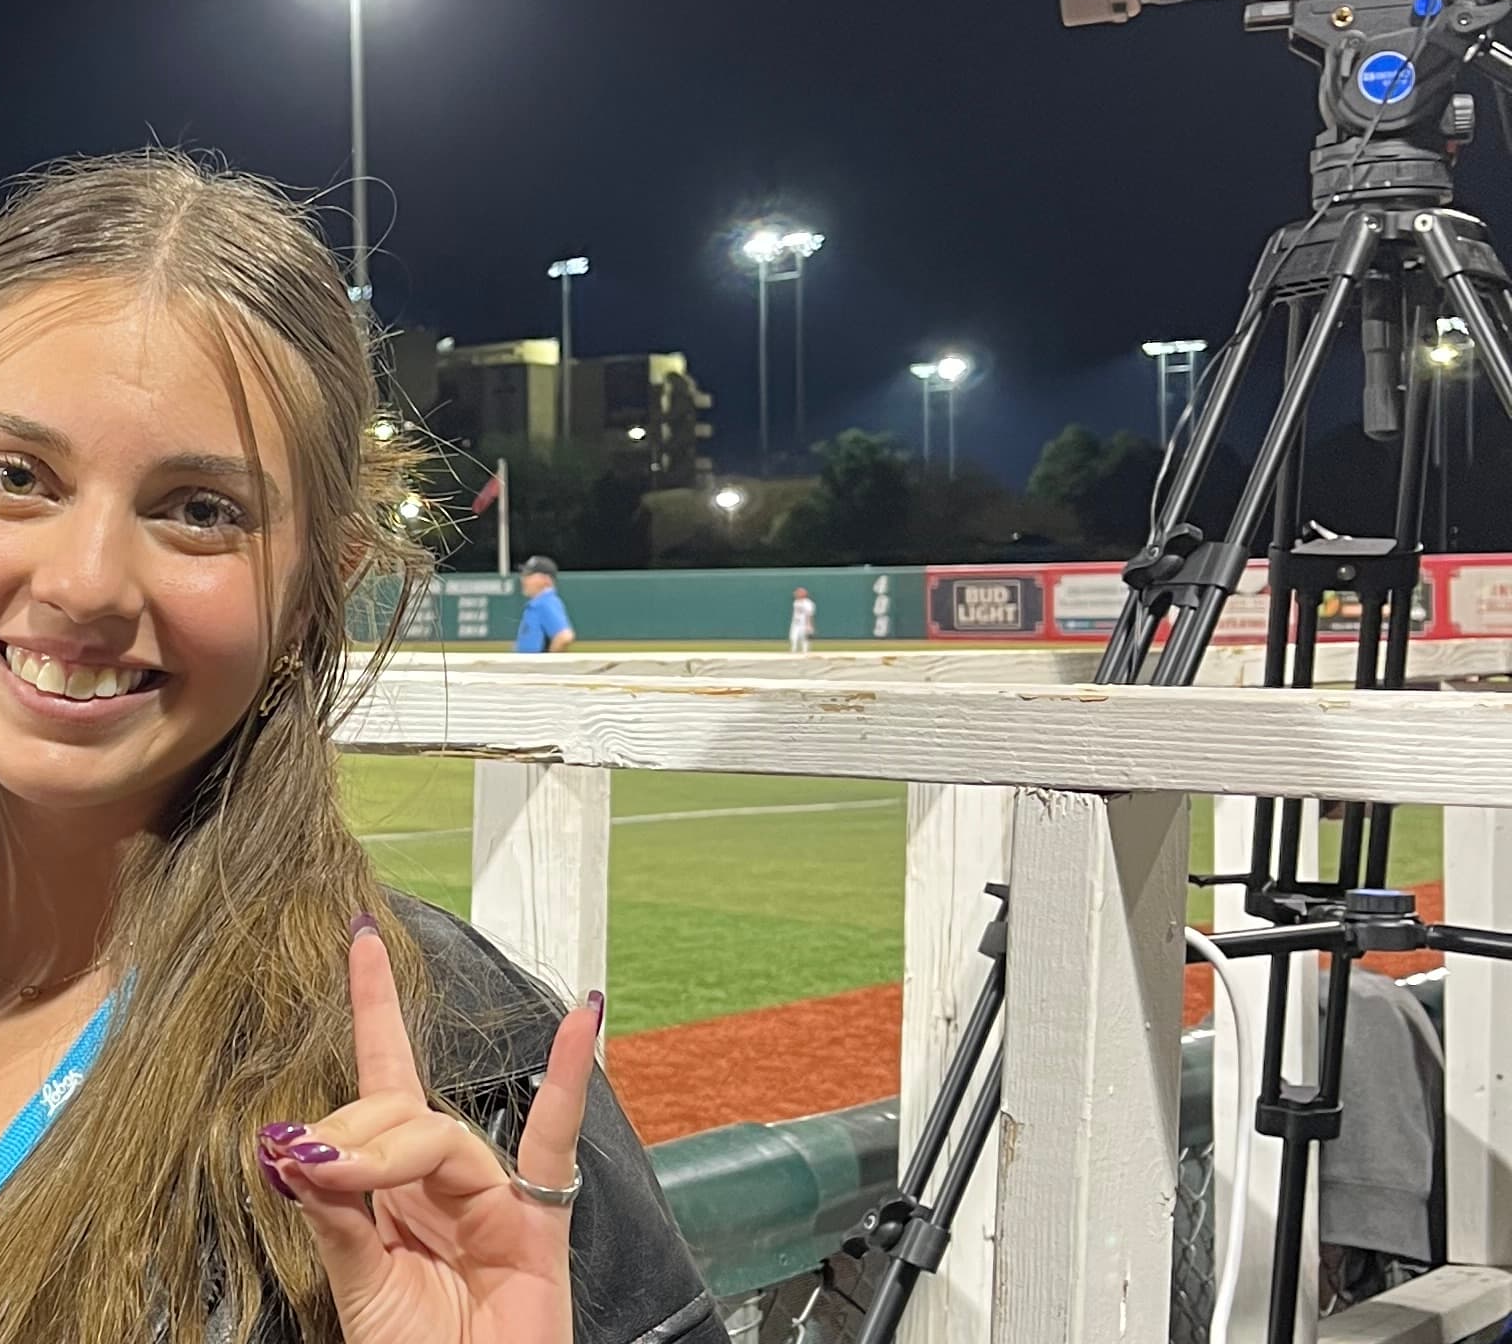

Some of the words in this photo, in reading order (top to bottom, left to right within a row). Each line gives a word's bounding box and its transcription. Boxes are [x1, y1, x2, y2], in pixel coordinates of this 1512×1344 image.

[964, 585, 1010, 604] BUD
[958, 603, 1018, 623] LIGHT
[40, 1070, 84, 1116] Lobos
